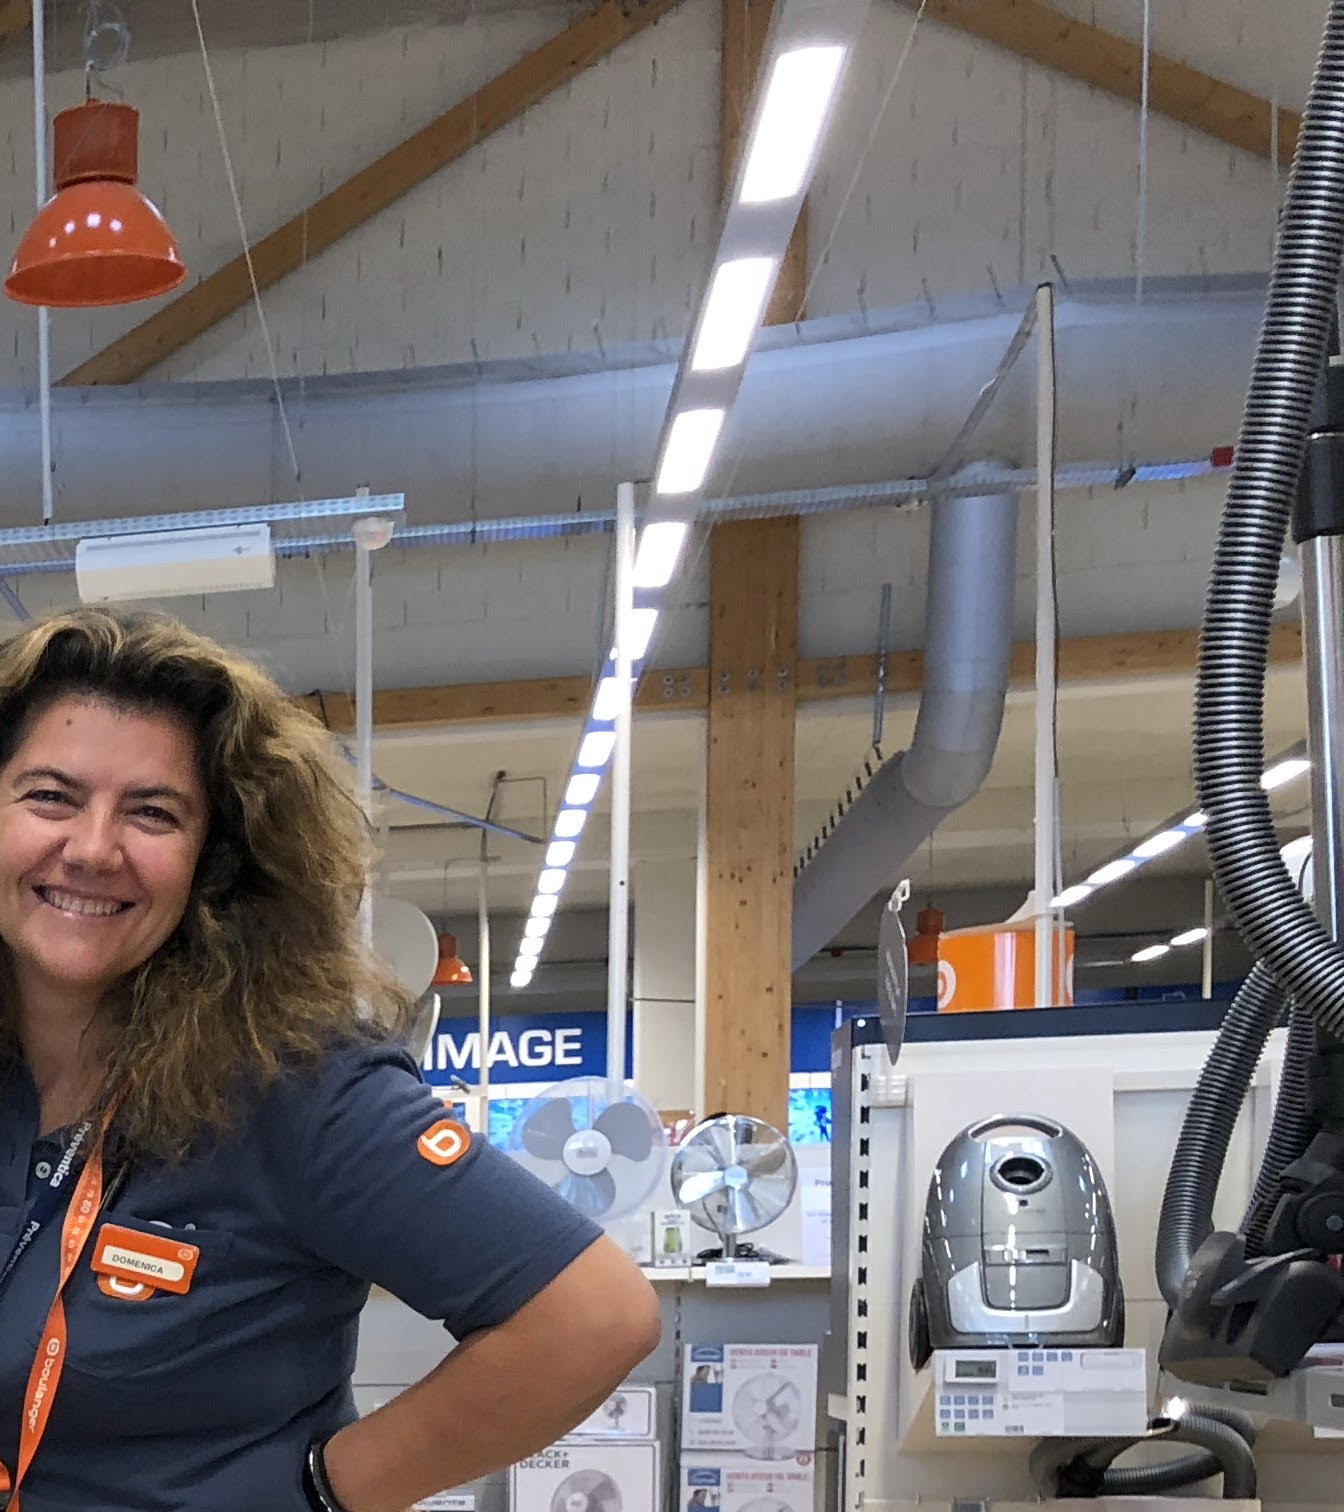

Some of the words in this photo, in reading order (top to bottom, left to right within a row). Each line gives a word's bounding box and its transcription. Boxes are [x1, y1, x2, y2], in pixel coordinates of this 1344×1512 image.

[424, 1028, 582, 1071] IMAGE
[49, 1121, 92, 1188] Préventica
[111, 1253, 164, 1275] DOMENICA
[28, 1358, 56, 1433] boulanger
[519, 1459, 570, 1469] DECKER
[537, 1449, 568, 1458] ACK+
